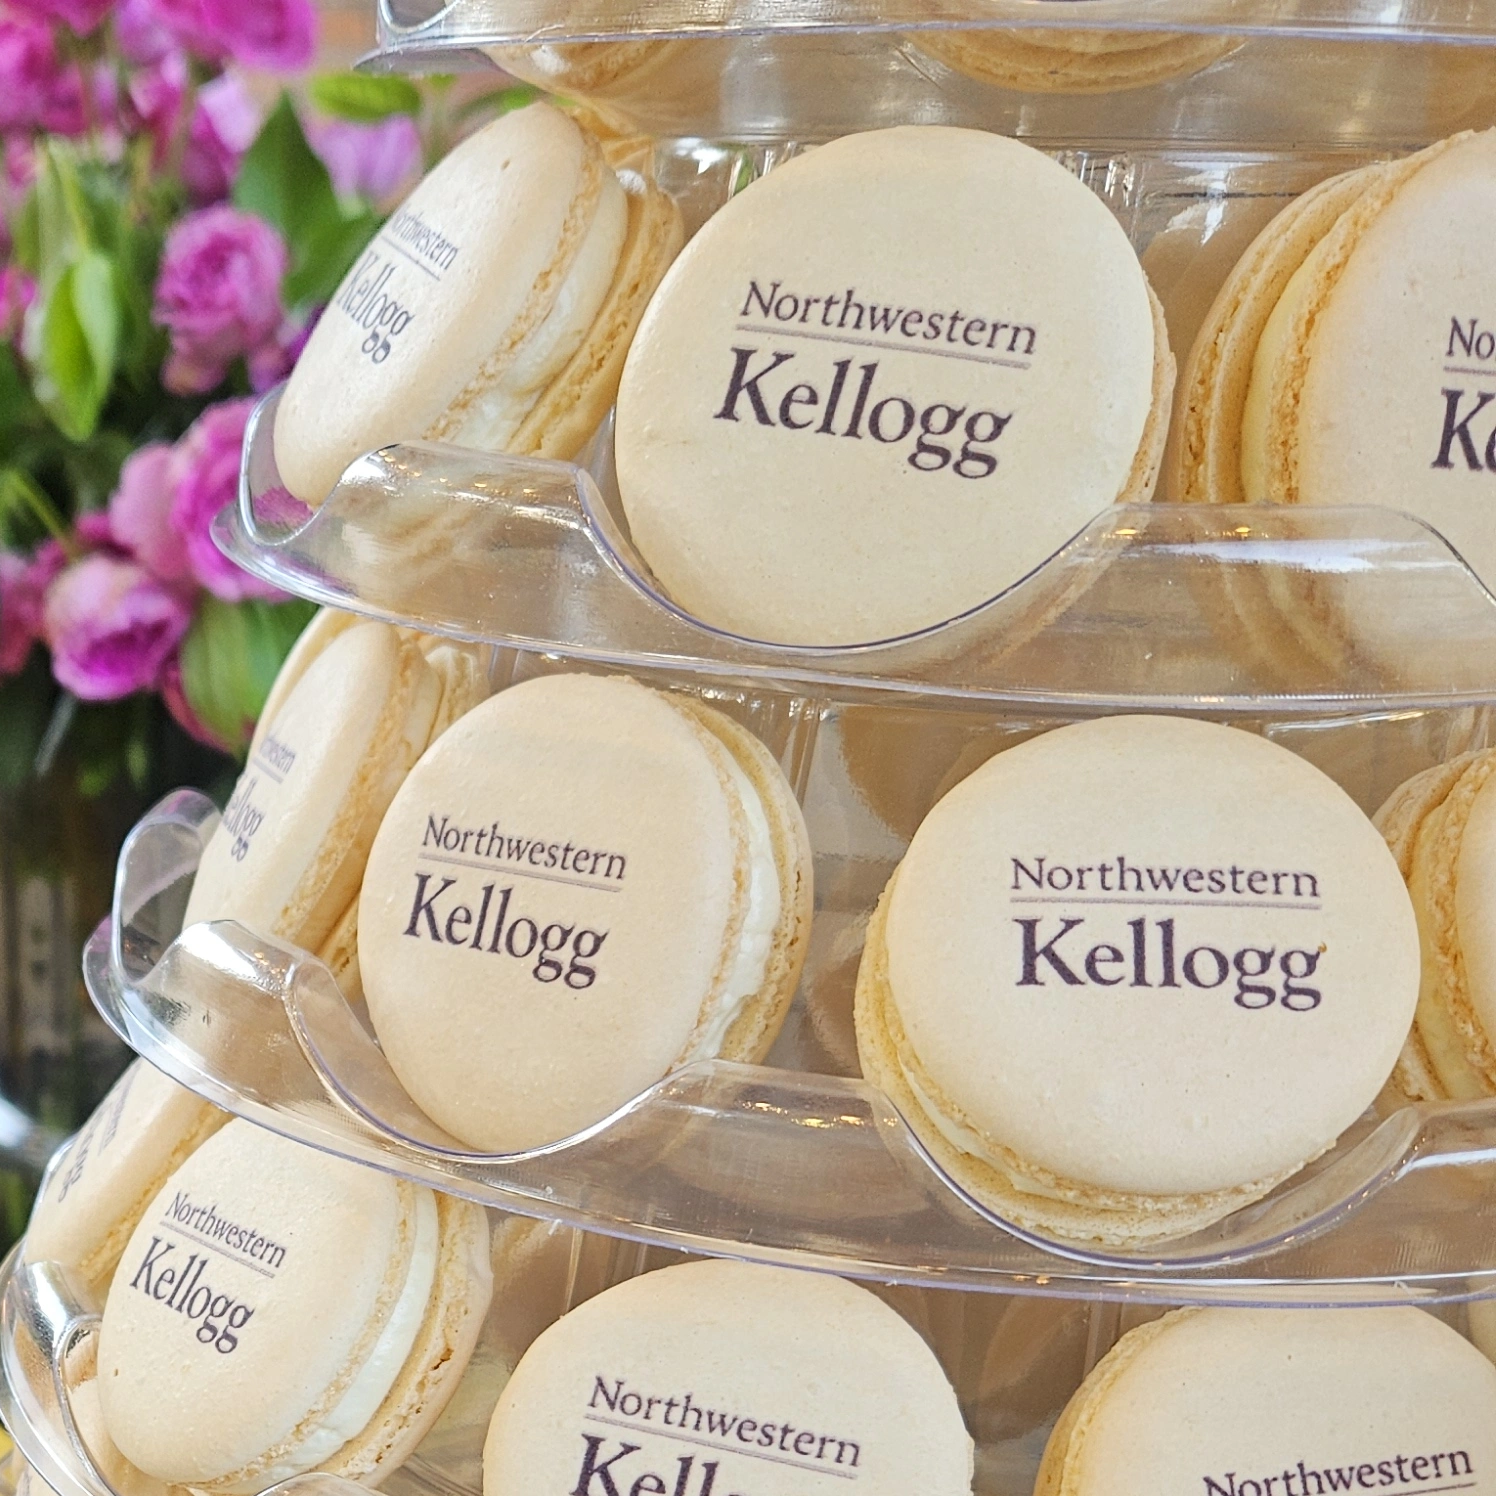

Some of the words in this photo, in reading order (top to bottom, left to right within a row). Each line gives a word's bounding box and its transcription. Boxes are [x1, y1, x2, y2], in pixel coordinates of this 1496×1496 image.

[337, 250, 416, 364] Kellogg
[739, 279, 1038, 356] Northwestern
[712, 345, 1014, 480] Kellogg
[421, 811, 627, 880] Northwestern
[1010, 855, 1321, 898] Northwestern
[402, 870, 610, 990] Kellogg
[1011, 915, 1322, 1012] Kellogg
[164, 1190, 287, 1269] Northwestern
[129, 1235, 256, 1355] Kellogg
[587, 1374, 862, 1468] Northwestern
